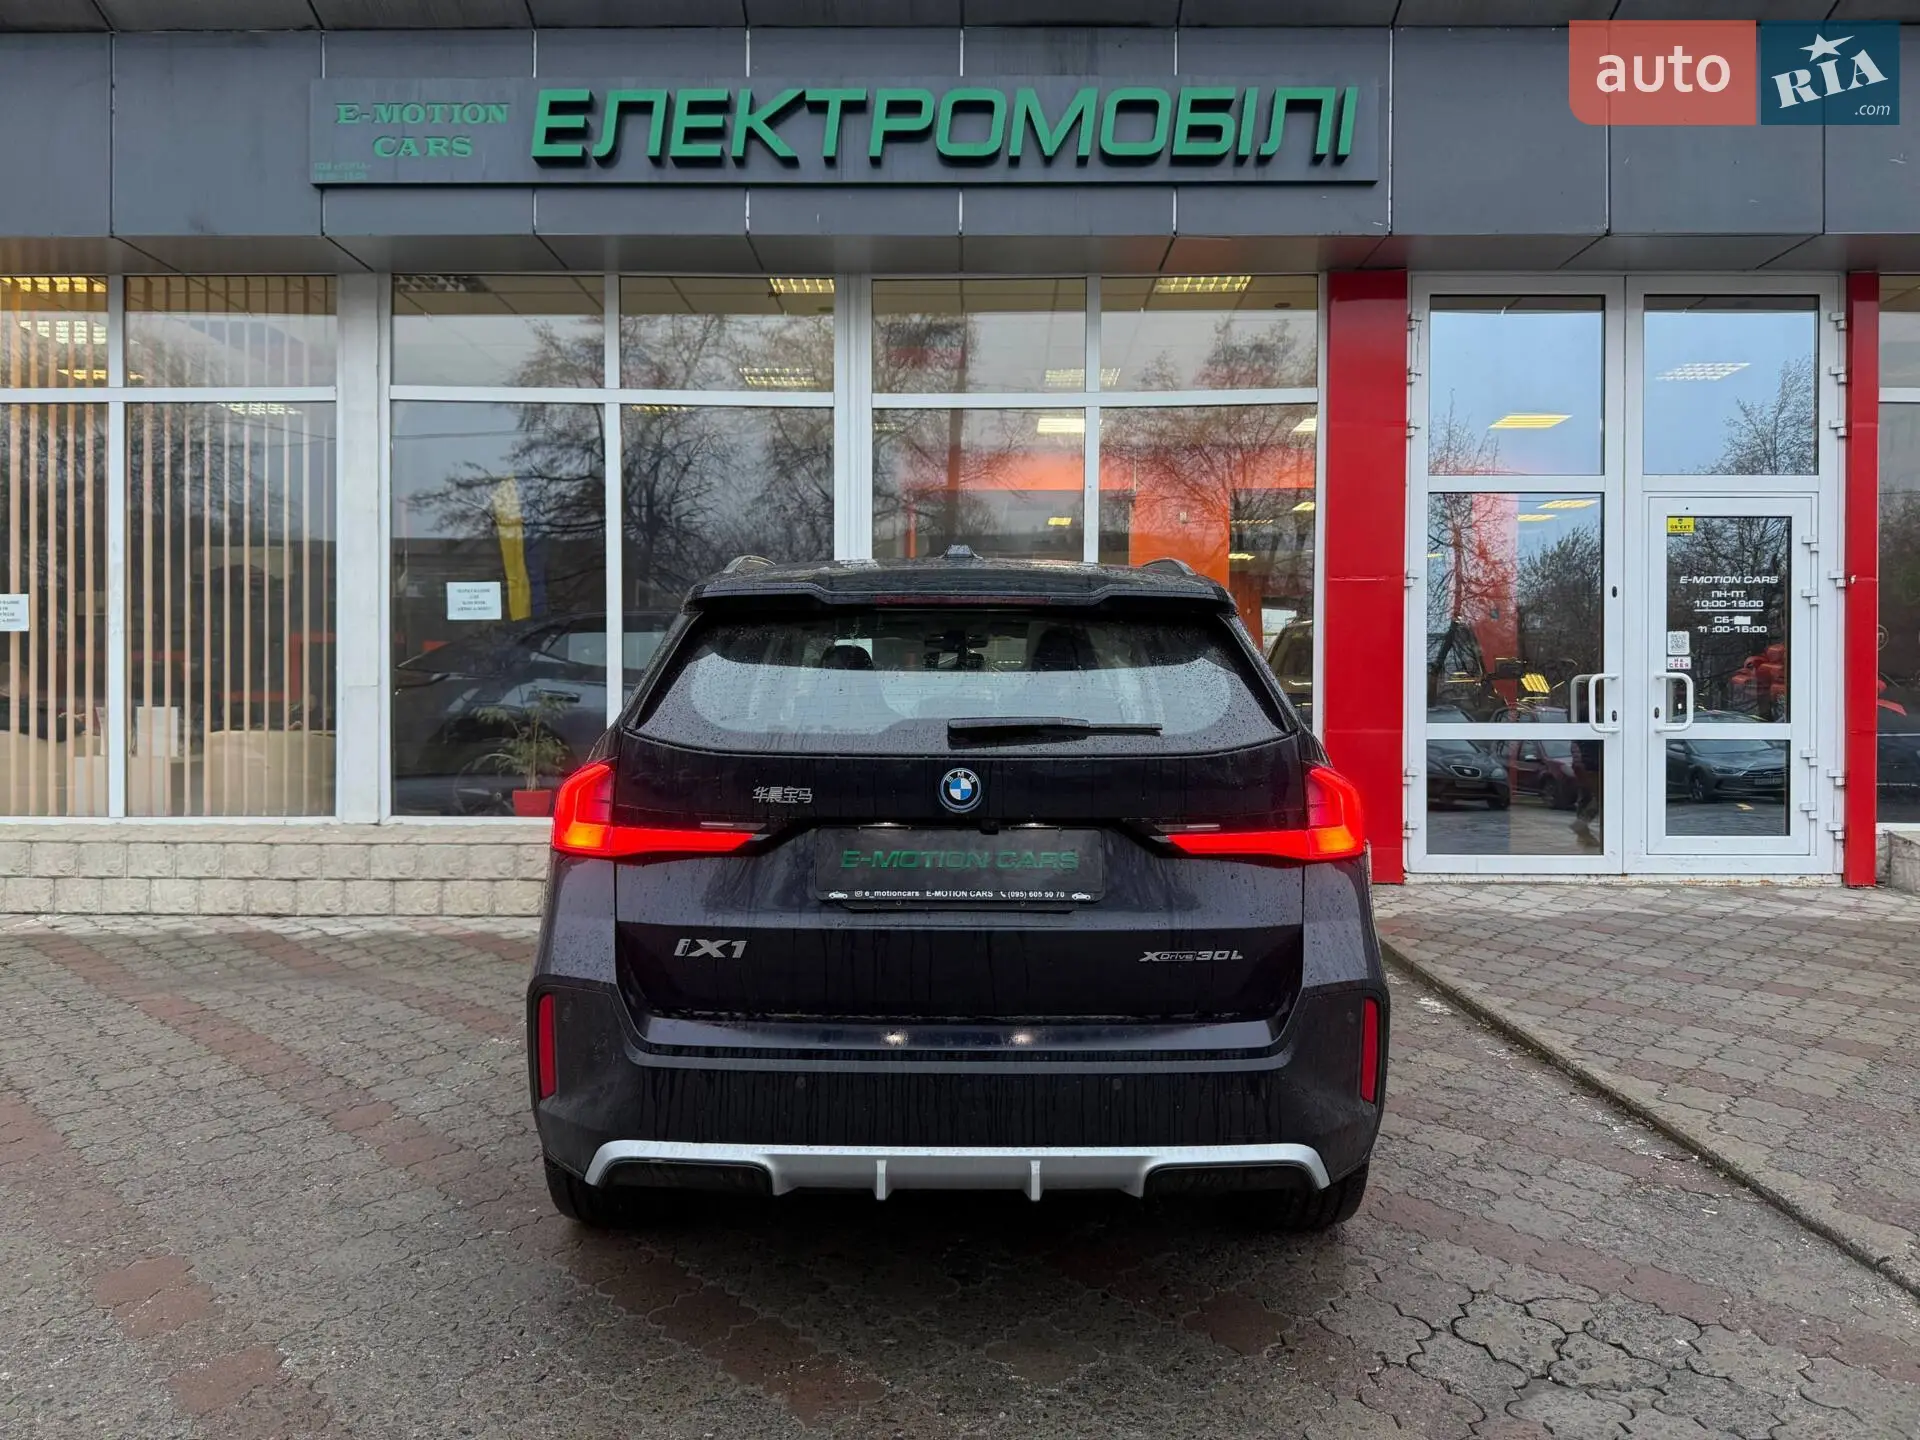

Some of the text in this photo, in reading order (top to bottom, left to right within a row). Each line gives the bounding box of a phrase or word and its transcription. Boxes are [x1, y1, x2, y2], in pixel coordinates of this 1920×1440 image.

[335, 102, 511, 125] E-MOTION
[531, 87, 1359, 160] ЕЛЕКТРОМОБІЛІ
[373, 135, 473, 158] CARS
[1679, 575, 1779, 584] E-MOTION CARS
[1711, 590, 1747, 598] ПН-ПТ
[1694, 600, 1764, 608] 10:00-19:00
[1714, 616, 1751, 625] СБ-
[945, 770, 976, 783] BMW
[752, 785, 813, 804] 华晨宝马
[840, 850, 1079, 871] E-MOTION CARS
[864, 890, 920, 899] e_motioncars
[926, 890, 968, 898] E-MOTION
[969, 890, 994, 898] CARS
